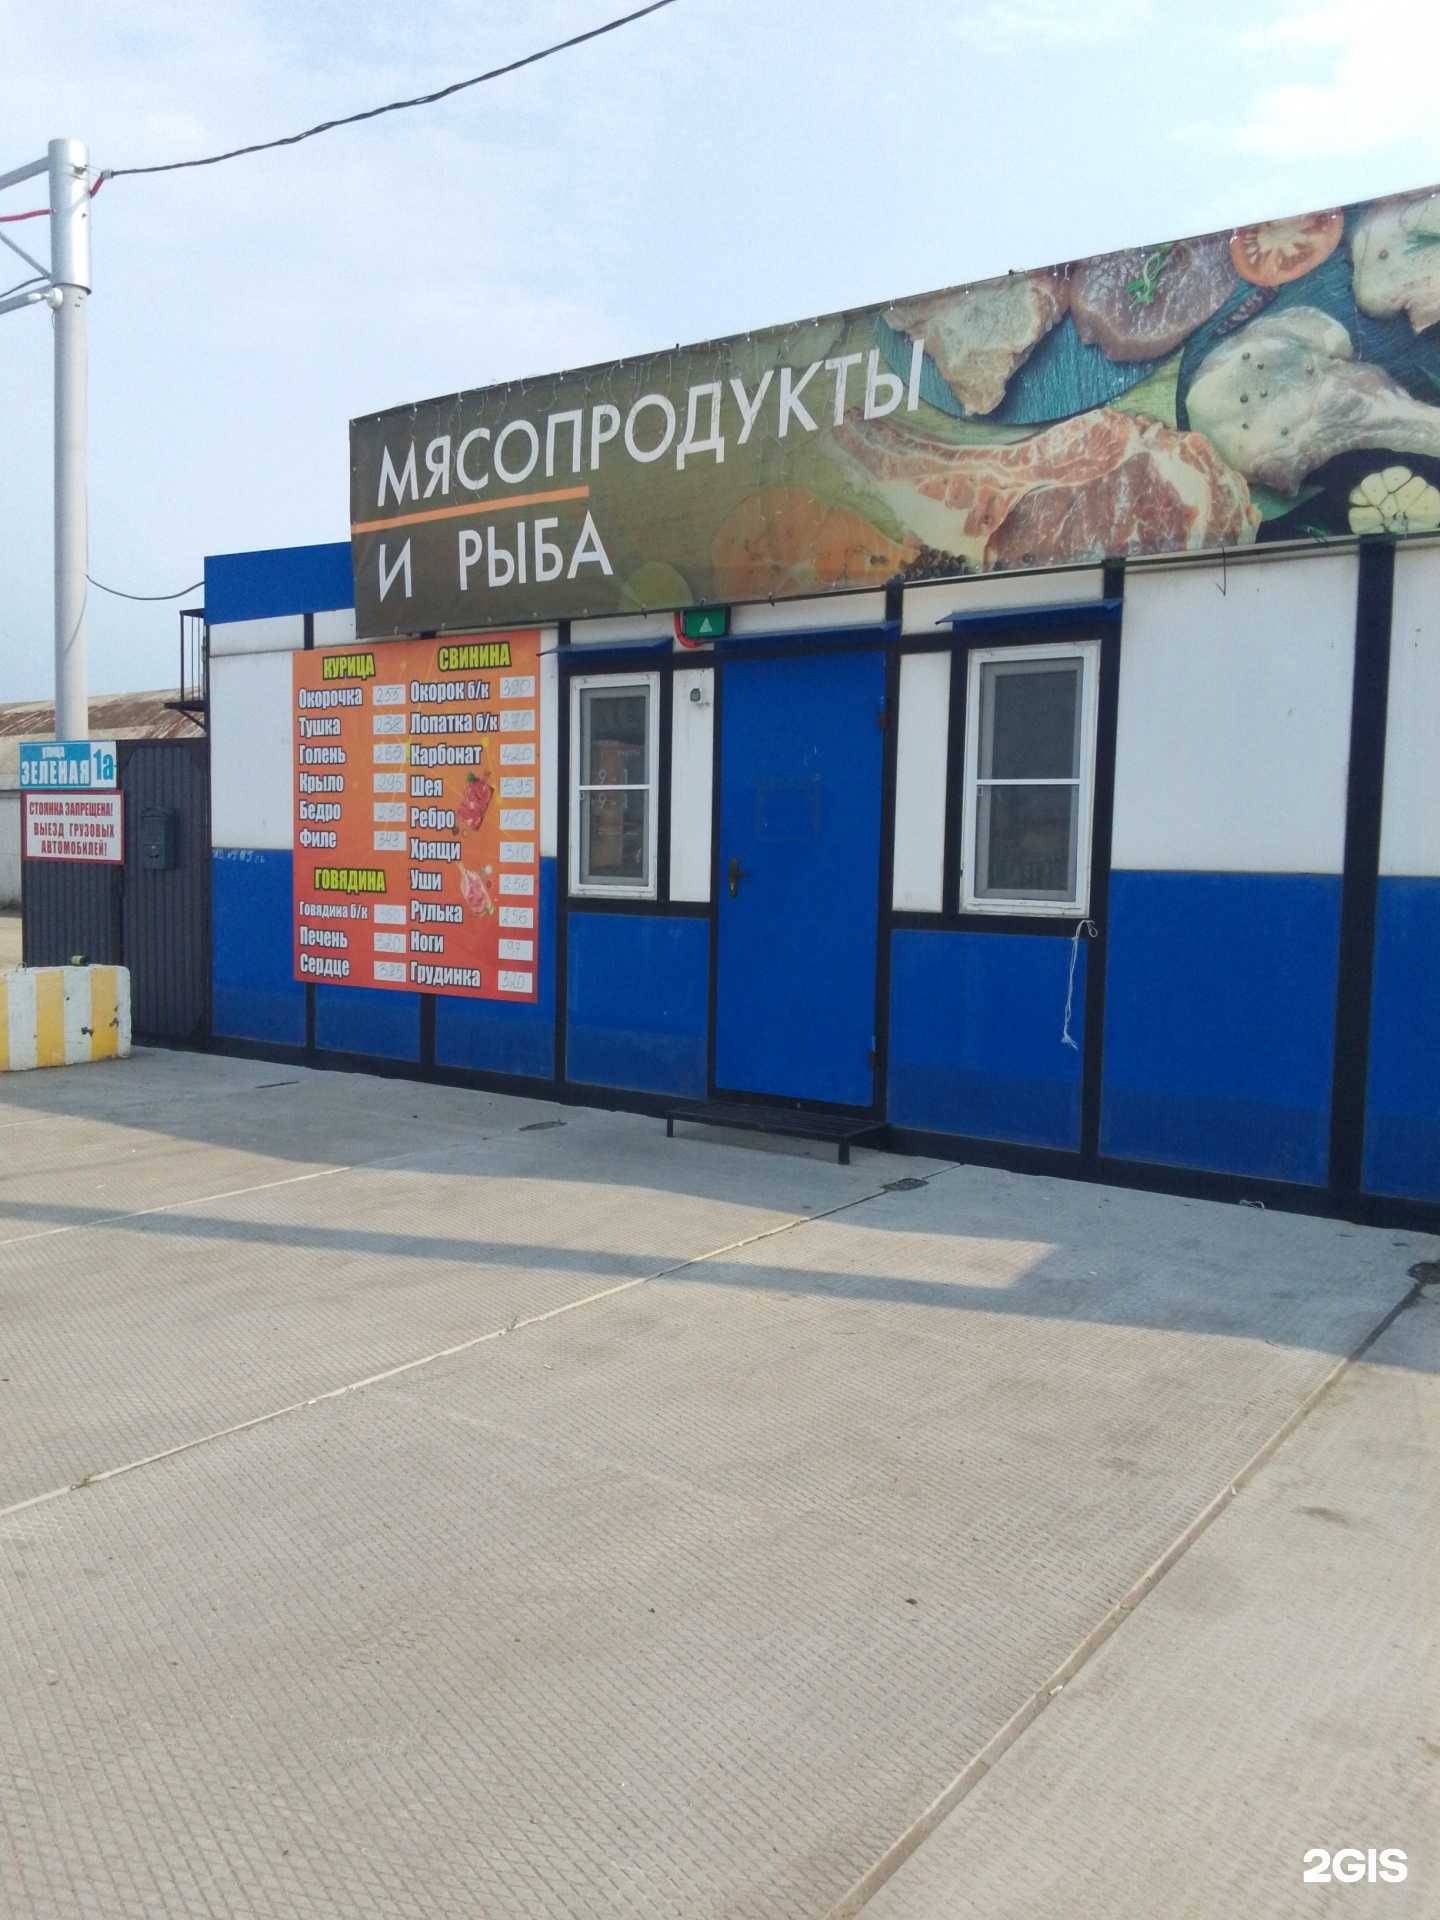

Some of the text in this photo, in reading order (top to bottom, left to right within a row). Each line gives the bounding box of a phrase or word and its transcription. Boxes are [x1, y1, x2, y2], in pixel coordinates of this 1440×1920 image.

[377, 338, 925, 507] МЯСОПРОДУКТЫ
[378, 510, 614, 602] И РЫБА
[323, 653, 376, 680] КУРИЦА
[438, 641, 511, 672] СВИНИНА
[298, 687, 363, 710] Окорочка
[410, 679, 490, 704] Окорок б/к
[299, 714, 341, 738] Тушка
[410, 713, 473, 735] Лопатка
[475, 713, 499, 732] б/к
[299, 744, 346, 765] Голень
[410, 744, 482, 768] Карбонат
[21, 760, 90, 785] ЗЕЛЕНАЯ
[299, 772, 344, 794] Крыло
[410, 775, 443, 797] Шея
[29, 801, 114, 817] СТОЯНКА ЗАПРЕЩЕНА!
[299, 800, 341, 823] Бедро
[410, 807, 455, 830] Ребро
[33, 822, 115, 838] ВЫЕЗД ГРУЗОВЫХ
[299, 828, 337, 848] Филе
[41, 840, 108, 857] АВТОМОБИЛЕЙ!
[410, 838, 461, 863] Хрящи
[314, 867, 387, 895] ГОВЯДИНА
[410, 869, 443, 891] Уши
[299, 901, 348, 919] Говядина
[350, 902, 368, 919] б/к
[410, 900, 463, 924] Рулька
[299, 926, 348, 949] Печень
[410, 930, 444, 953] Ноги
[299, 952, 350, 977] Сердце
[410, 961, 481, 988] Грудинка
